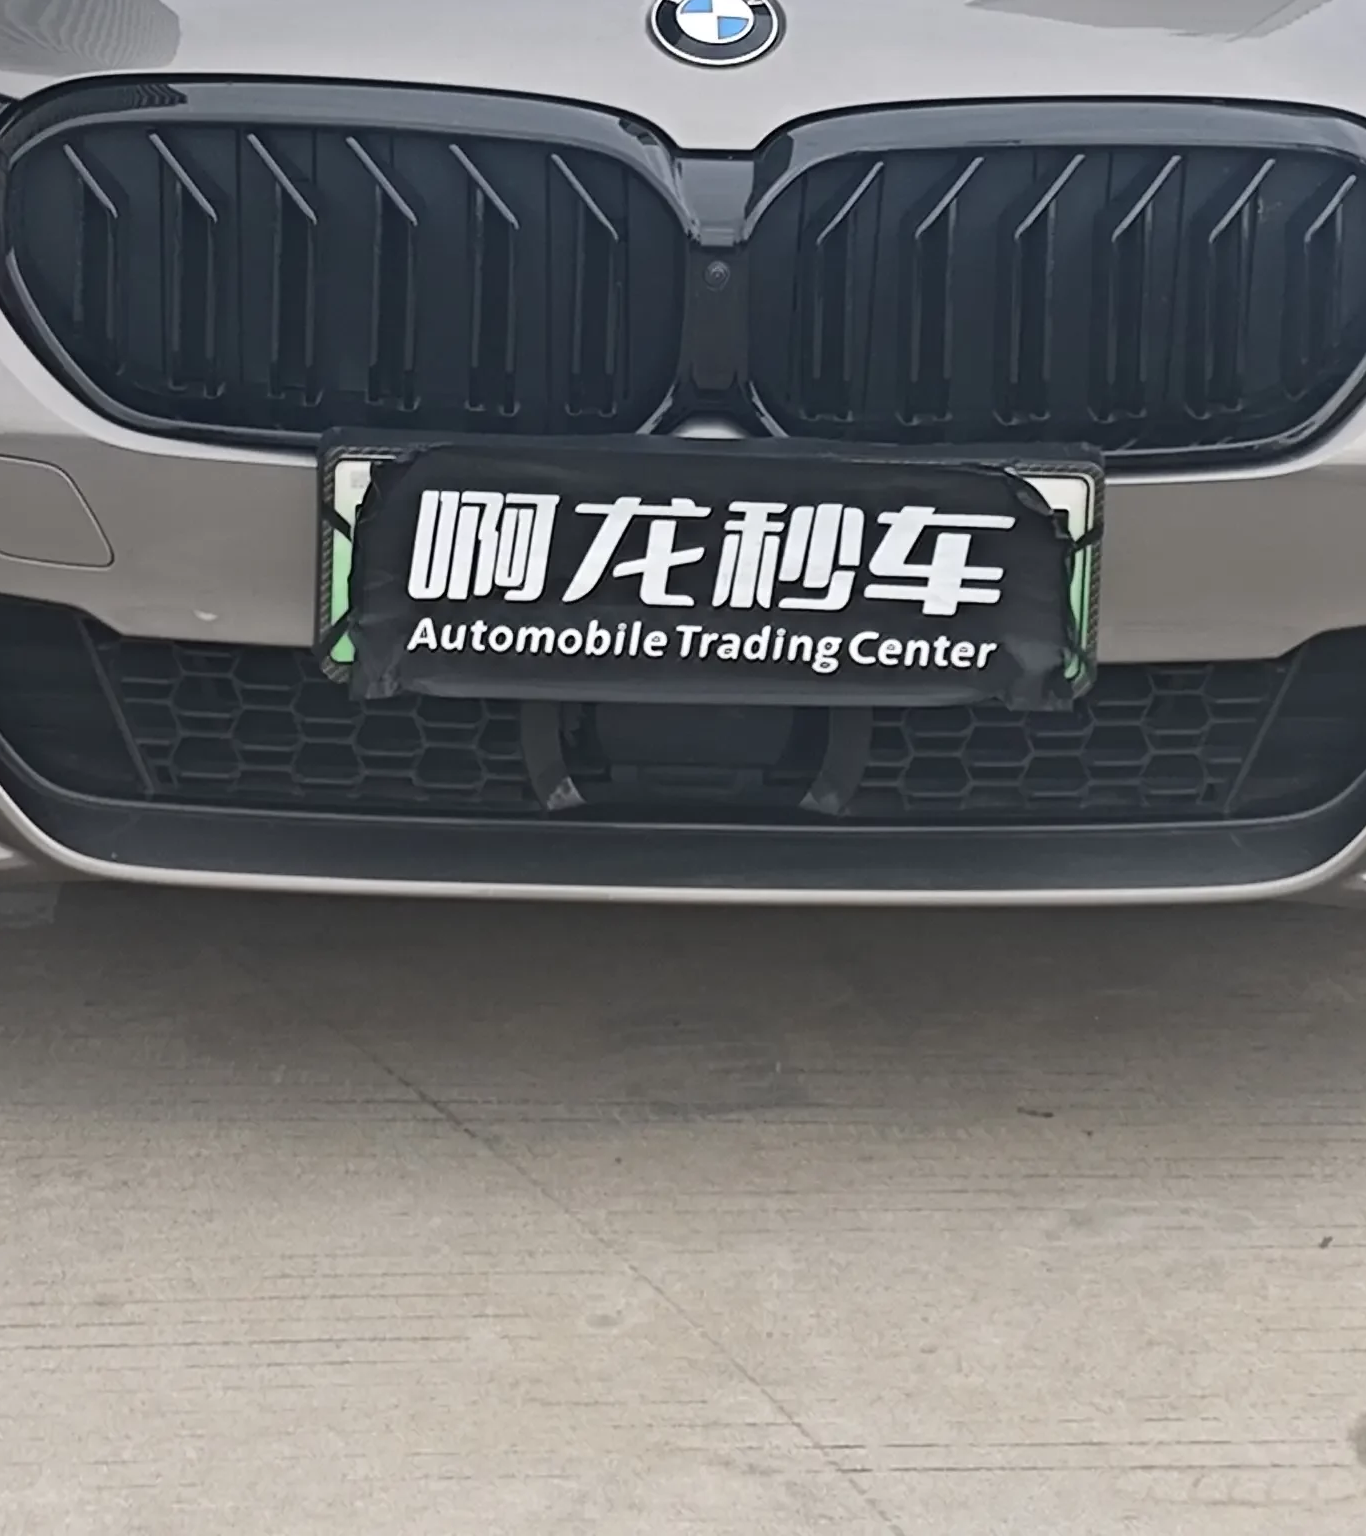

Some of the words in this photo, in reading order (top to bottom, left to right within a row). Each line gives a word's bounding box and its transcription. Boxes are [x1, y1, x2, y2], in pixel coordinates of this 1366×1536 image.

[408, 489, 1016, 616] 啊龙秒车
[406, 617, 668, 658] Automobile
[676, 624, 843, 674] Trading
[848, 630, 998, 669] Center
